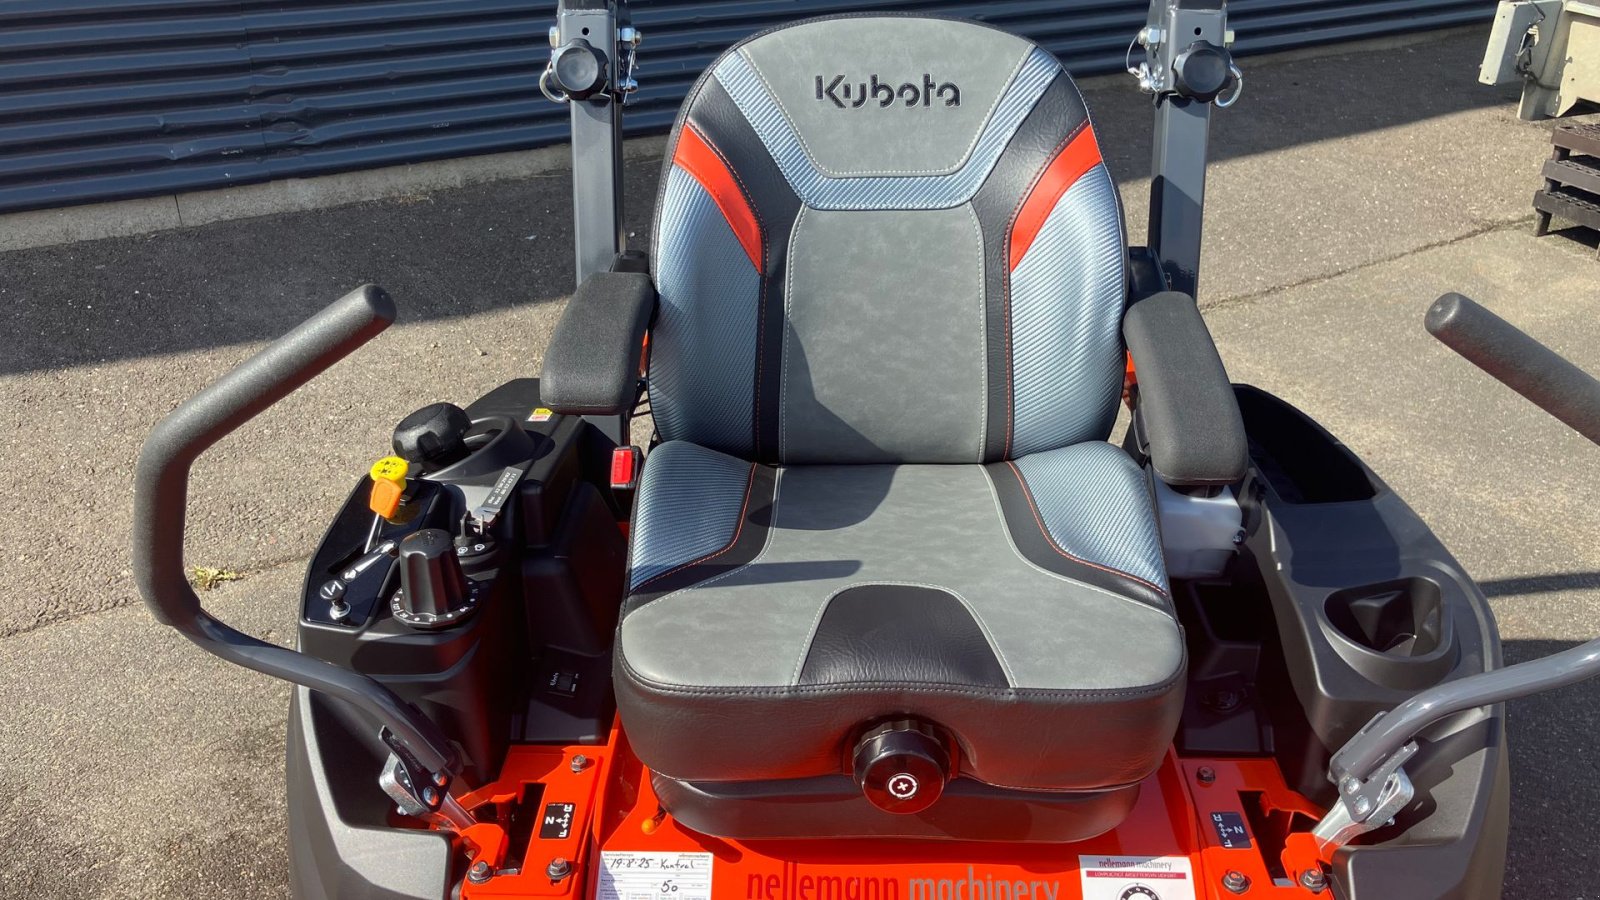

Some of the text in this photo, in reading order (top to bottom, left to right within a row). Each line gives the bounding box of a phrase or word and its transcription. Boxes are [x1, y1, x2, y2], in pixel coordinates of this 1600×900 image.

[815, 73, 961, 109] Kubota
[545, 816, 555, 825] N
[1233, 825, 1244, 834] N
[747, 861, 1060, 900] nellemann machinery
